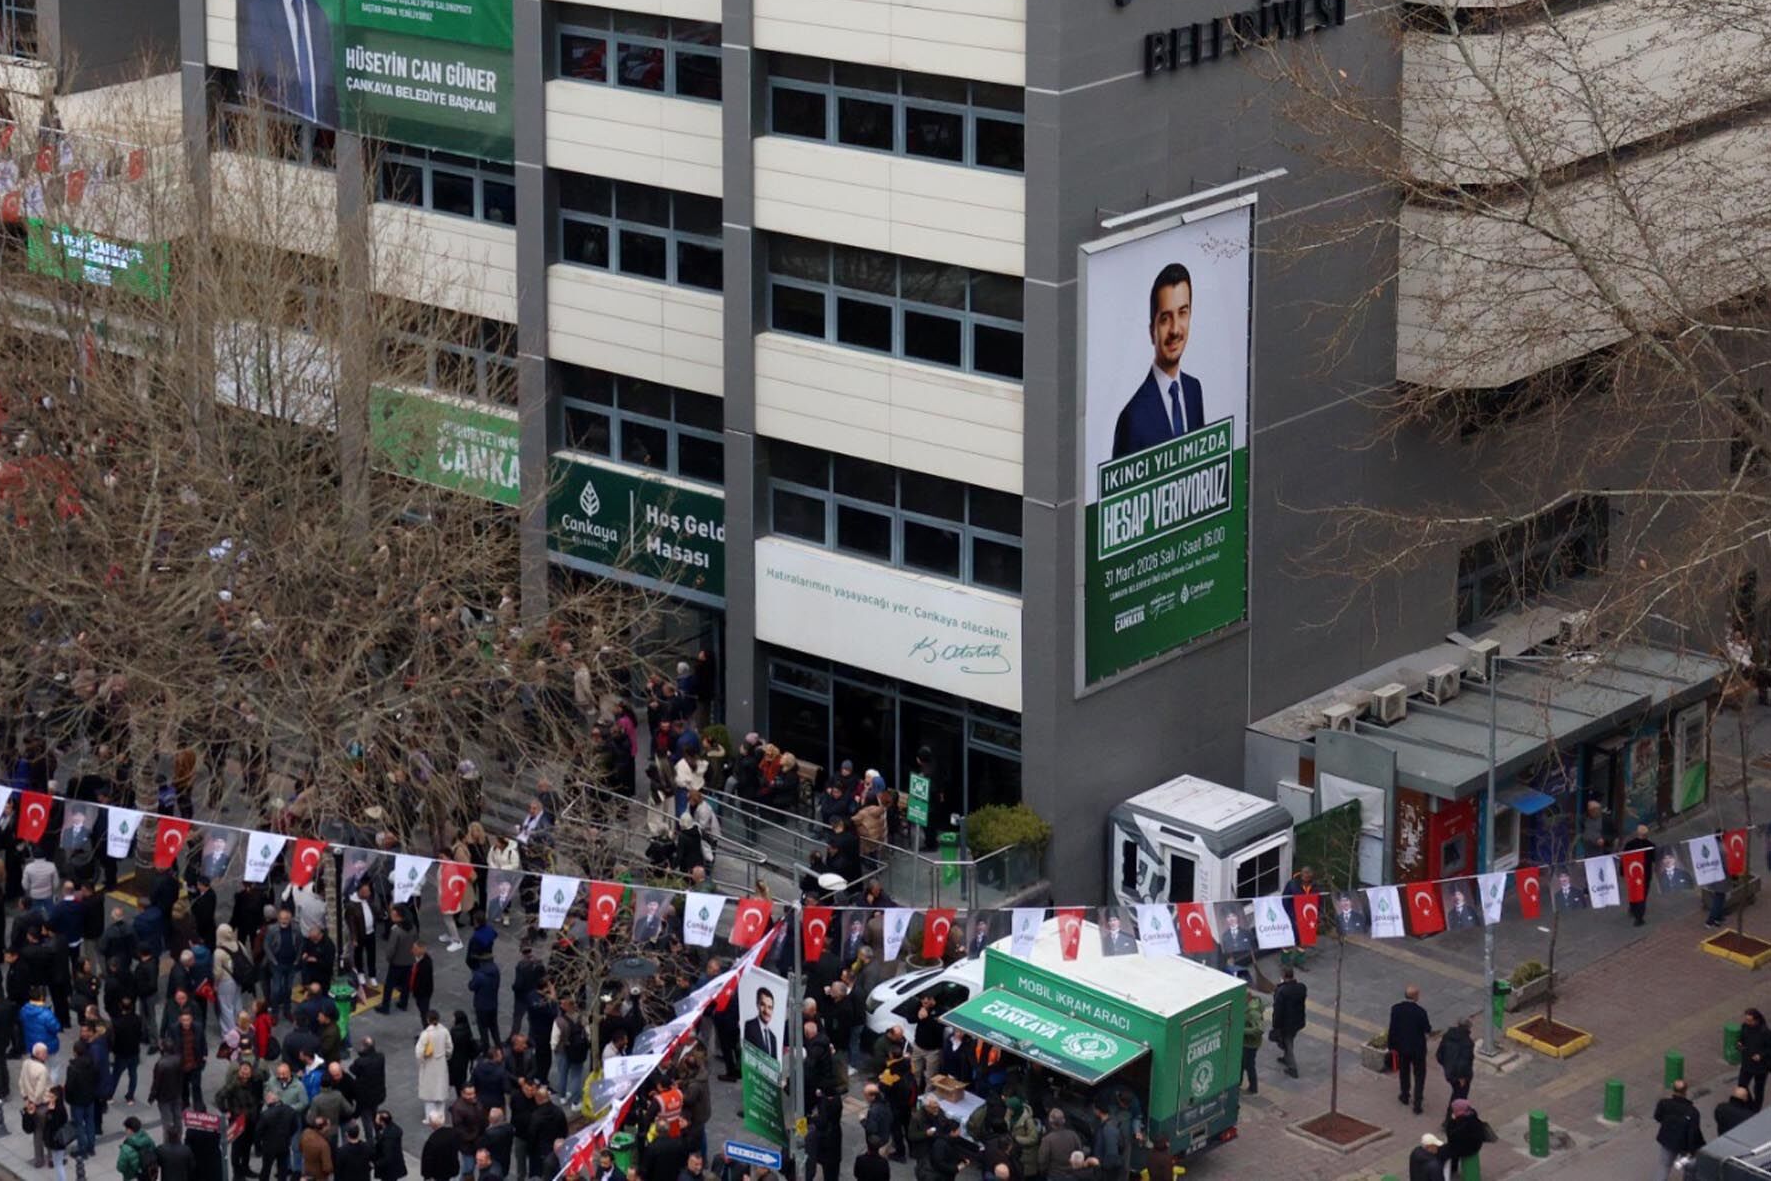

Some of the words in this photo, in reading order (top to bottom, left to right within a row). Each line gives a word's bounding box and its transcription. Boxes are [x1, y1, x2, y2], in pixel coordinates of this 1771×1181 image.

[345, 45, 408, 79] HÜSEYİN
[411, 58, 442, 86] CAN
[446, 61, 497, 93] GÜNER
[345, 77, 394, 97] ÇANKAYA
[395, 83, 447, 106] BELEDİYE
[448, 92, 497, 115] BAŞKANI
[1104, 458, 1150, 492] İKİNCİ
[1154, 430, 1227, 473] YILIMIZDA
[561, 514, 618, 543] Çankaya
[646, 504, 681, 533] Hoş
[1103, 491, 1151, 550] HESAP
[1152, 462, 1228, 530] VERİYORUZ
[646, 534, 709, 568] Masası
[1104, 570, 1114, 588] 31
[1115, 562, 1136, 584] Mart
[1137, 552, 1159, 573] 2026
[1160, 547, 1175, 567] Salı
[1182, 535, 1203, 558] Saat
[766, 568, 832, 593] Hatıralarımın
[833, 586, 890, 610] yaşayacağı
[892, 602, 913, 617] yer,
[914, 606, 959, 629] Çankaya
[961, 620, 1011, 641] olacaktır.
[981, 1002, 1060, 1039] ÇANKAYA
[1018, 976, 1053, 1001] MOBİL
[1055, 992, 1092, 1015] İKRAM
[1093, 1007, 1130, 1030] ARACI
